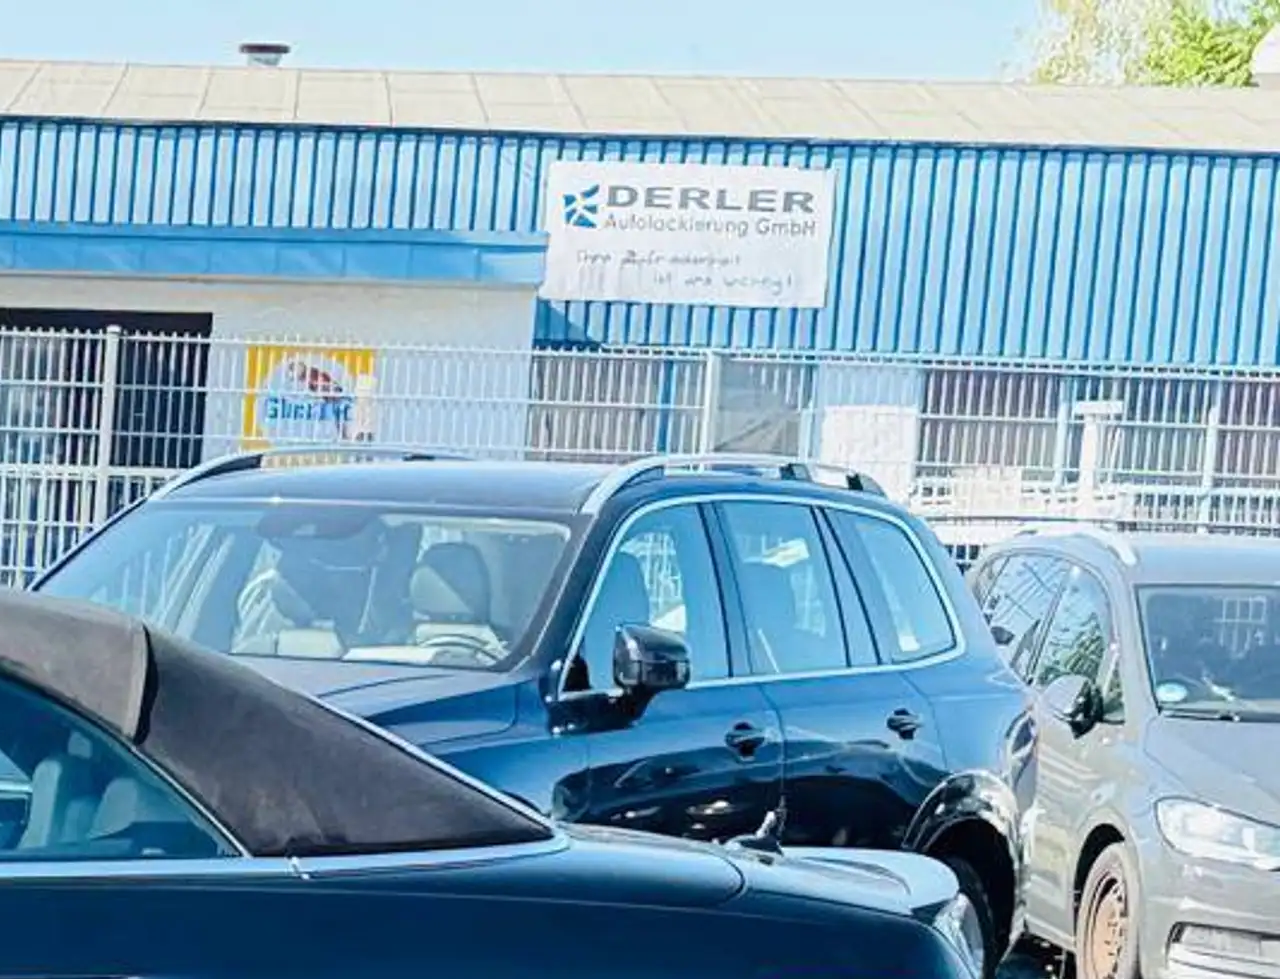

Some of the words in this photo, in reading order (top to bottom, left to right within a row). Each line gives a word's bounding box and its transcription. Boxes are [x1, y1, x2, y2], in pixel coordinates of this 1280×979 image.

[607, 185, 815, 213] DERLER
[604, 214, 748, 237] Autolackierung
[756, 218, 816, 236] GmbH
